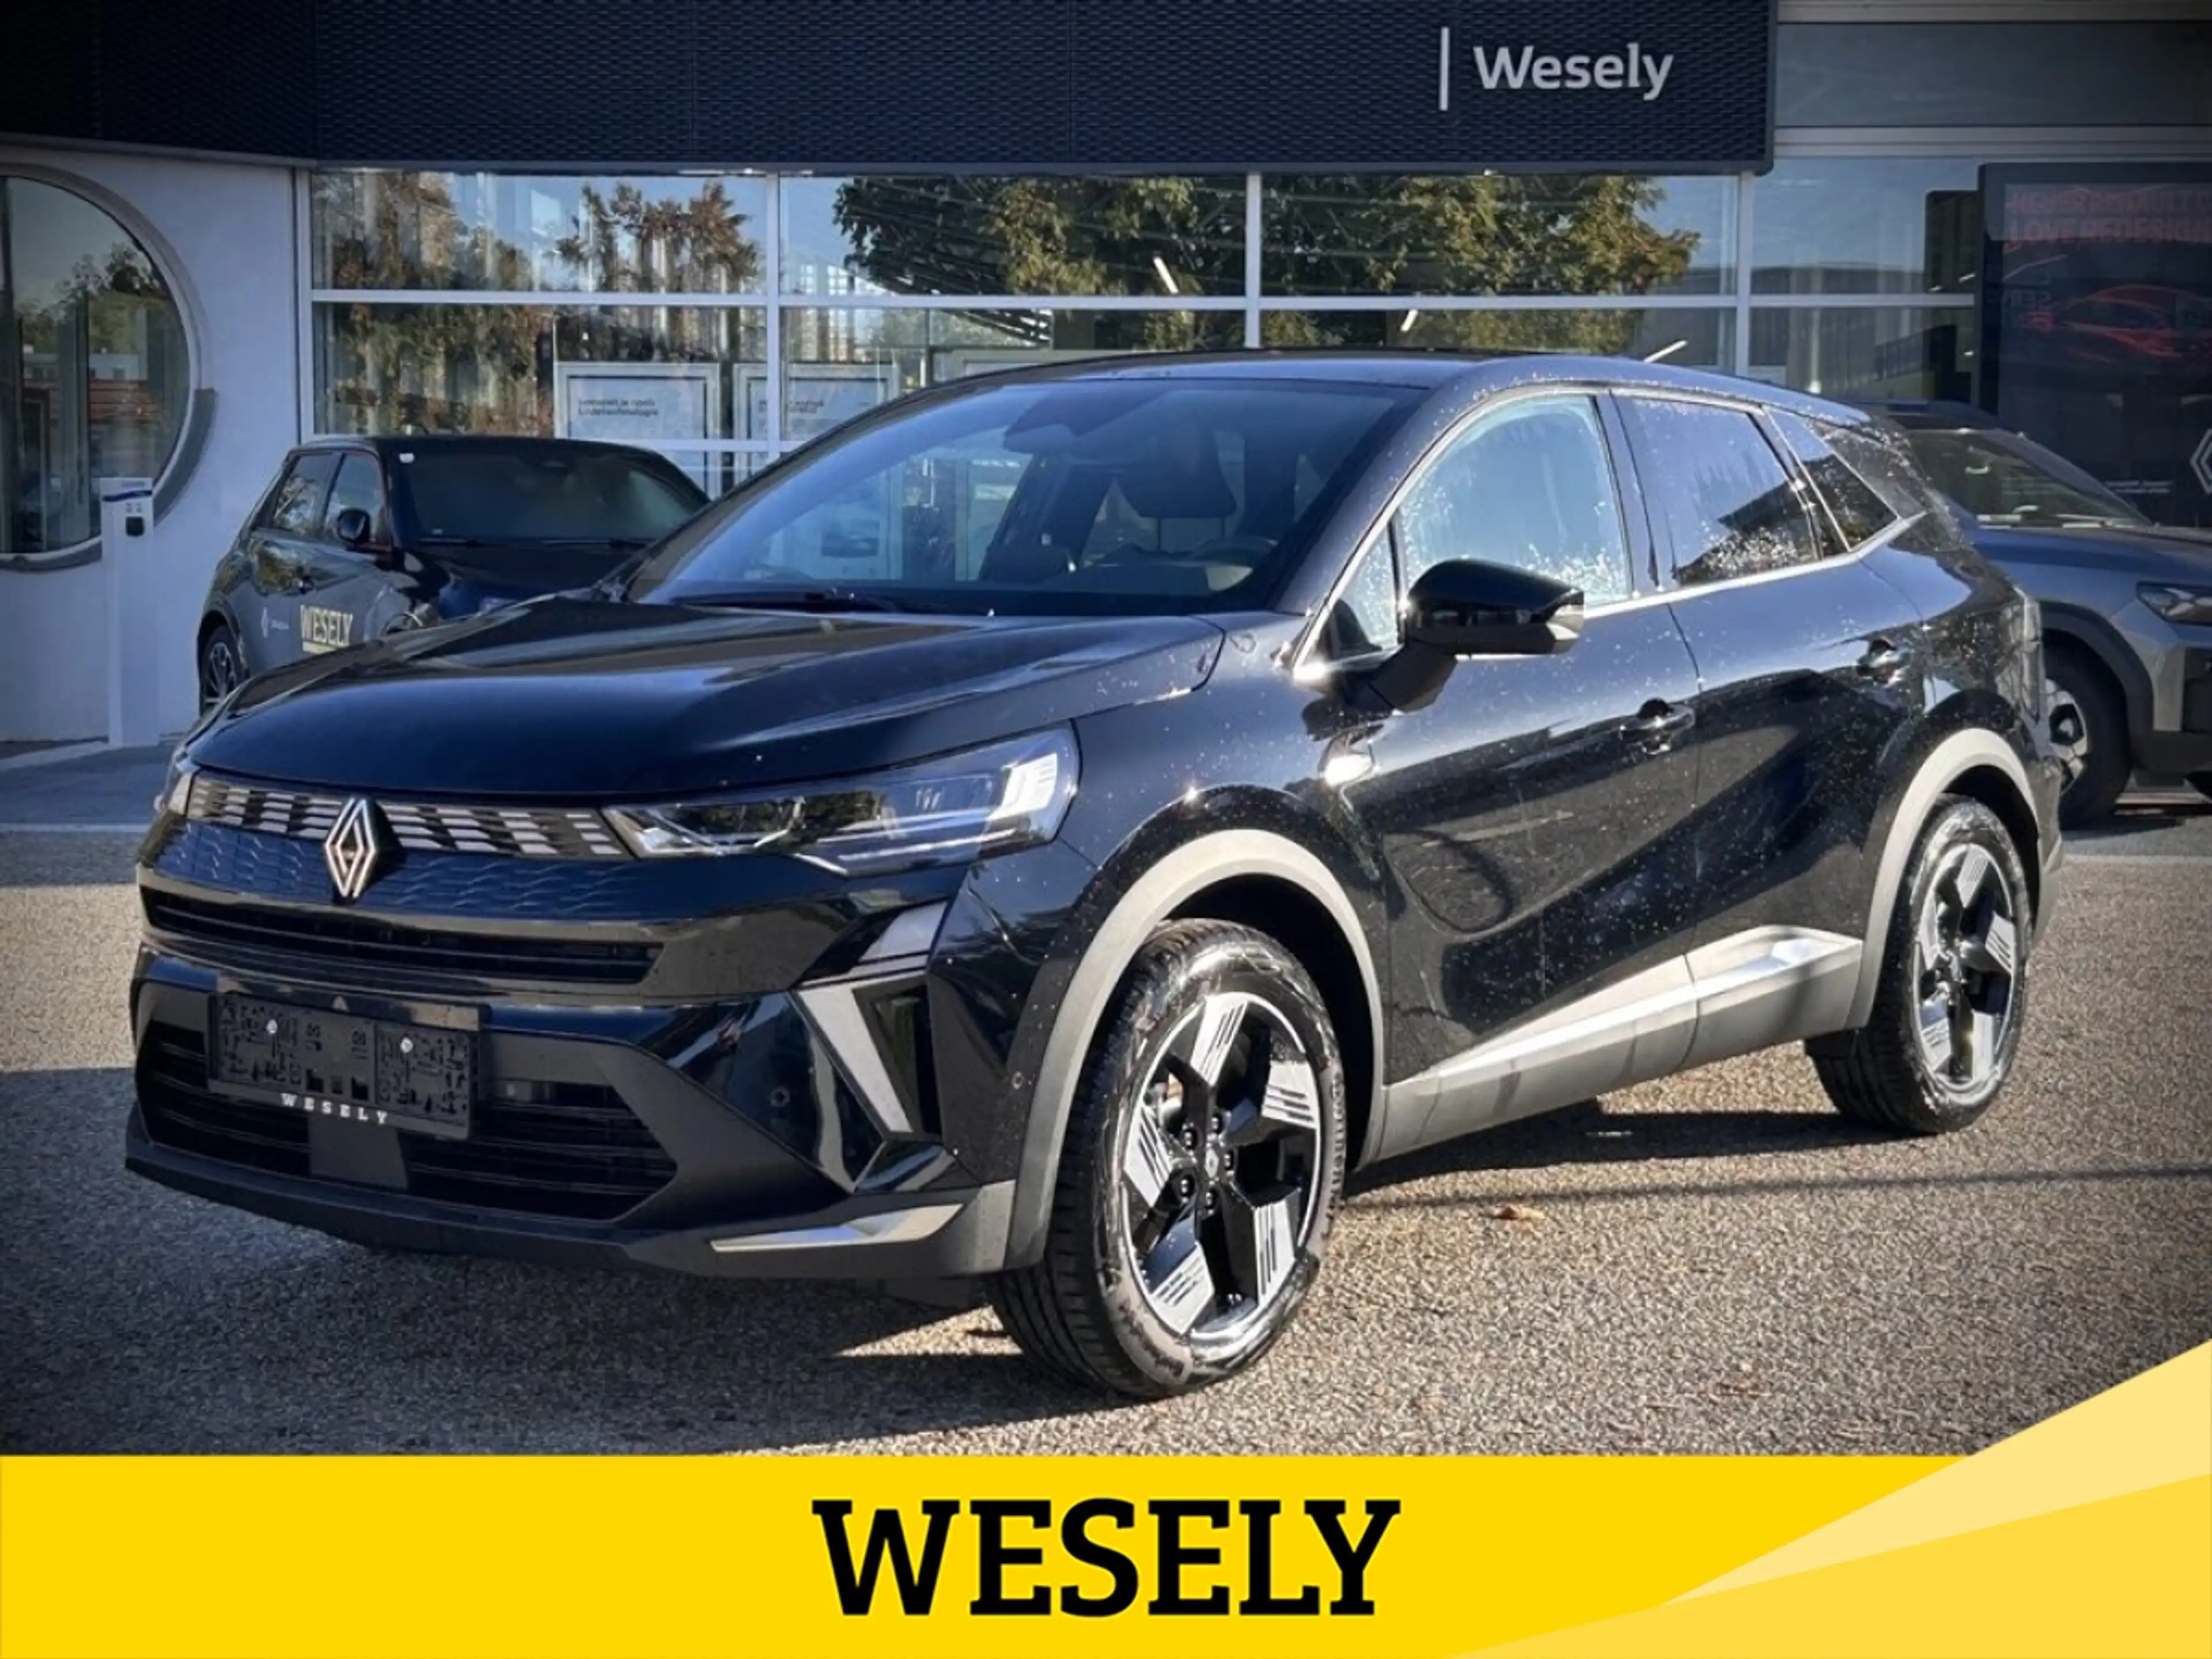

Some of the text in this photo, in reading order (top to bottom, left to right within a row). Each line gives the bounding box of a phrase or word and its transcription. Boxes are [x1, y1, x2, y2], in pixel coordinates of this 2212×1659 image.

[1472, 42, 1674, 100] Wesely
[300, 604, 353, 646] WESELY
[280, 1093, 388, 1125] WESELY
